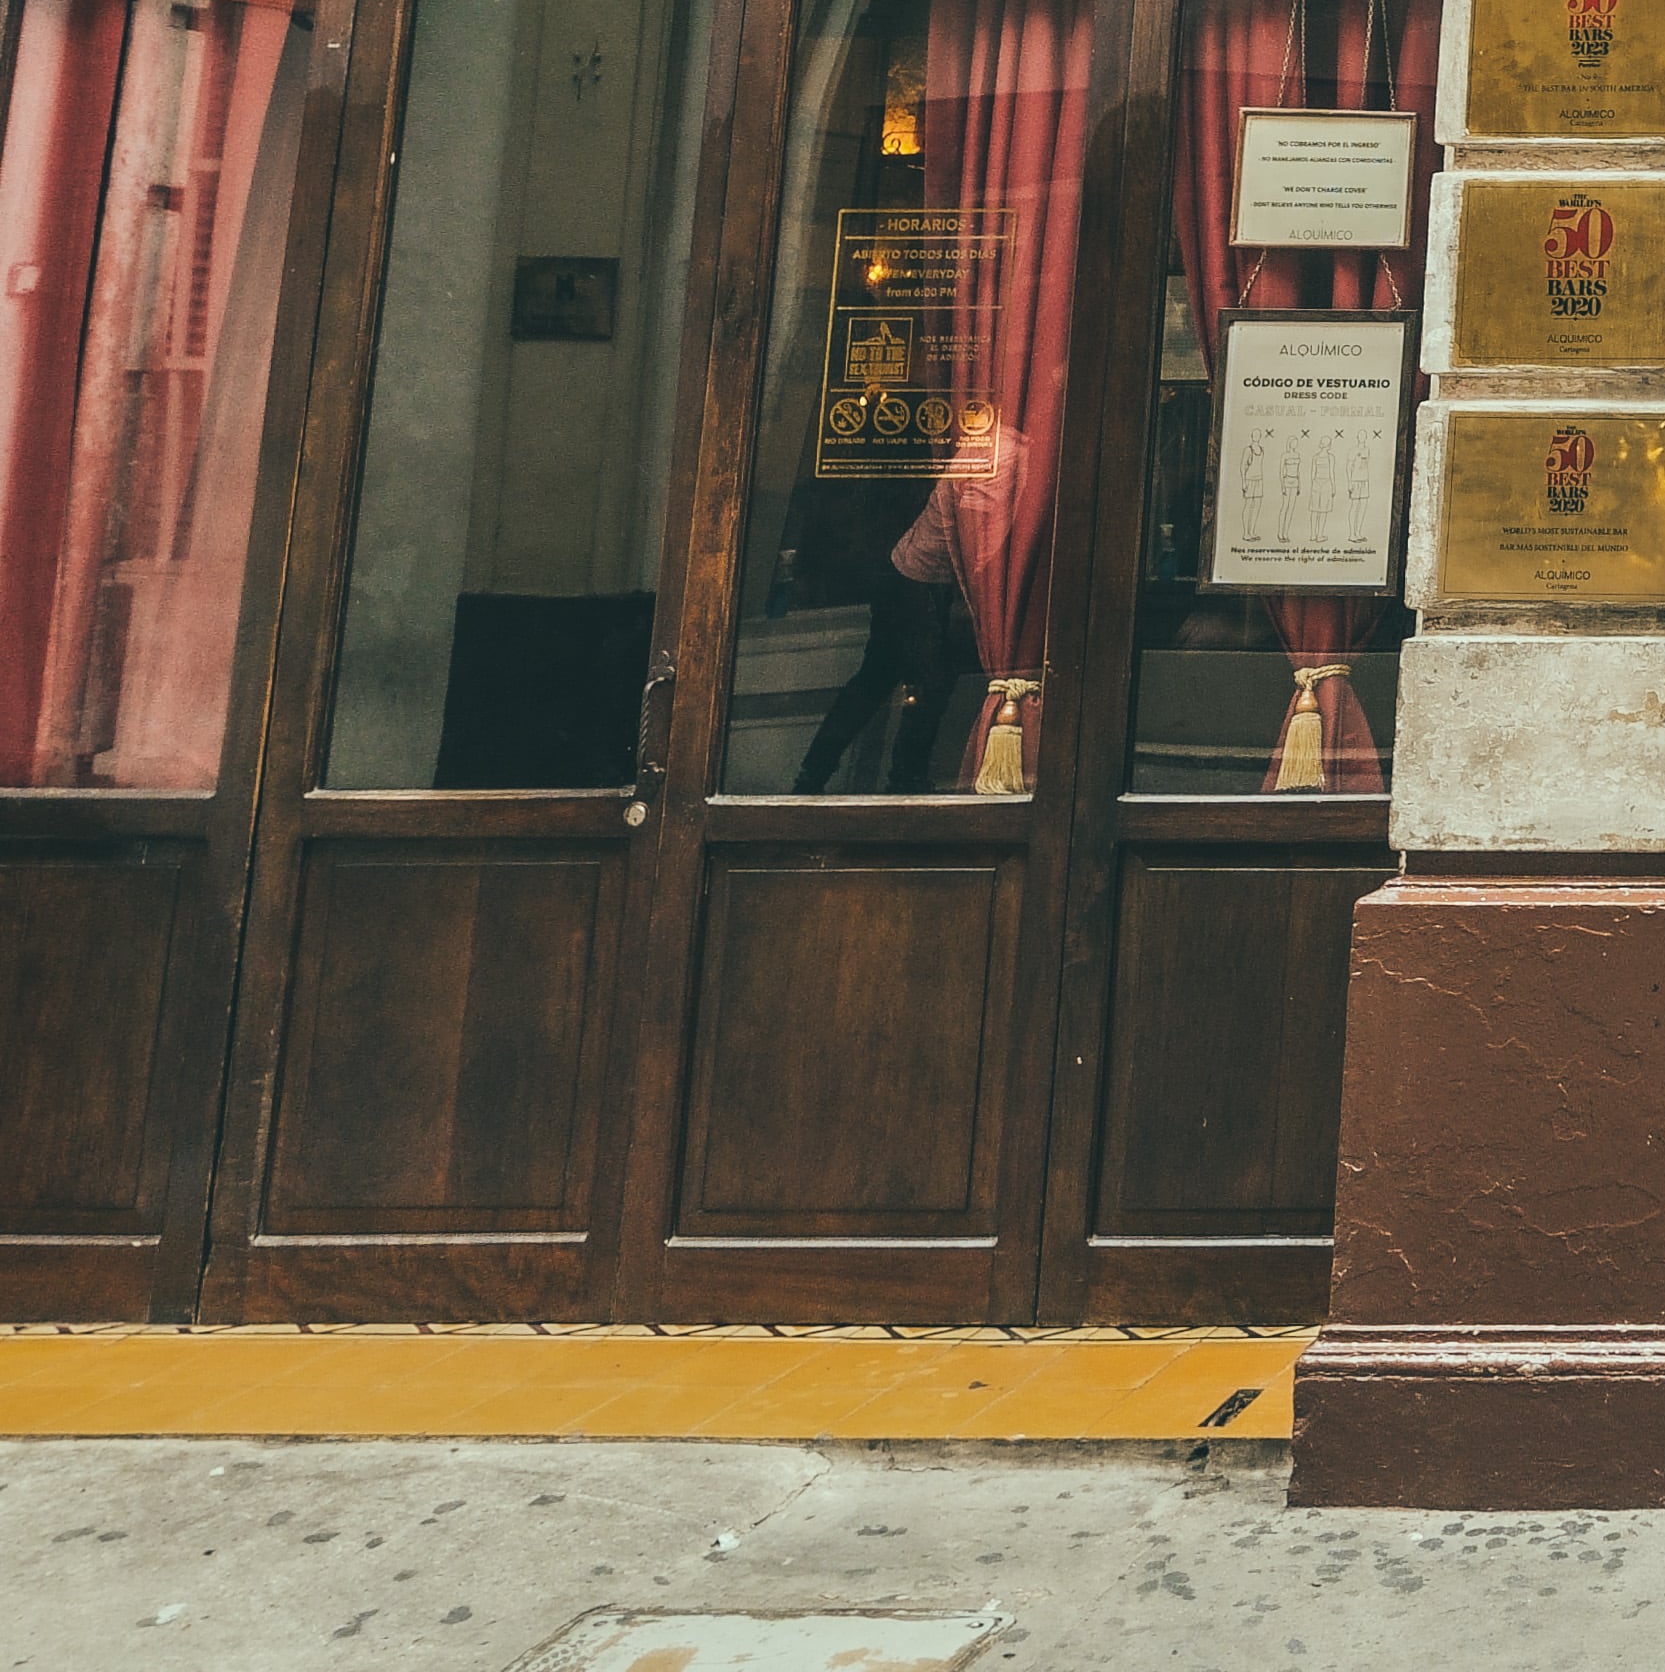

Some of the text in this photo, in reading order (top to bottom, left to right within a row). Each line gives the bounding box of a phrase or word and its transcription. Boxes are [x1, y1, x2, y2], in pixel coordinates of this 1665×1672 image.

[1569, 14, 1616, 29] BEST
[1569, 29, 1613, 41] BARS
[1571, 41, 1609, 56] 2023
[887, 219, 965, 231] HORARIOS
[1544, 208, 1613, 259] 50
[904, 249, 943, 259] TODOS
[945, 249, 965, 260] LOS
[911, 268, 969, 279] EVERYDAY
[1544, 260, 1610, 279] BEST
[886, 287, 911, 297] from
[940, 287, 957, 297] PM
[1545, 279, 1608, 297] BARS
[1551, 297, 1600, 316] 2020
[1243, 376, 1391, 389] CÓDIGO DE VESTUARIO
[1284, 391, 1348, 400] DRESS CODE
[1244, 404, 1306, 417] CASUAL
[1546, 436, 1595, 472] 50
[1547, 472, 1592, 486] BEST
[1546, 486, 1589, 499] BARS
[1549, 499, 1585, 513] 2020
[1538, 527, 1559, 535] MOST
[1561, 527, 1610, 535] SUSTAINABLE
[1612, 528, 1628, 536] BAR
[1581, 544, 1596, 552] DEL
[1597, 544, 1629, 552] MUNDO
